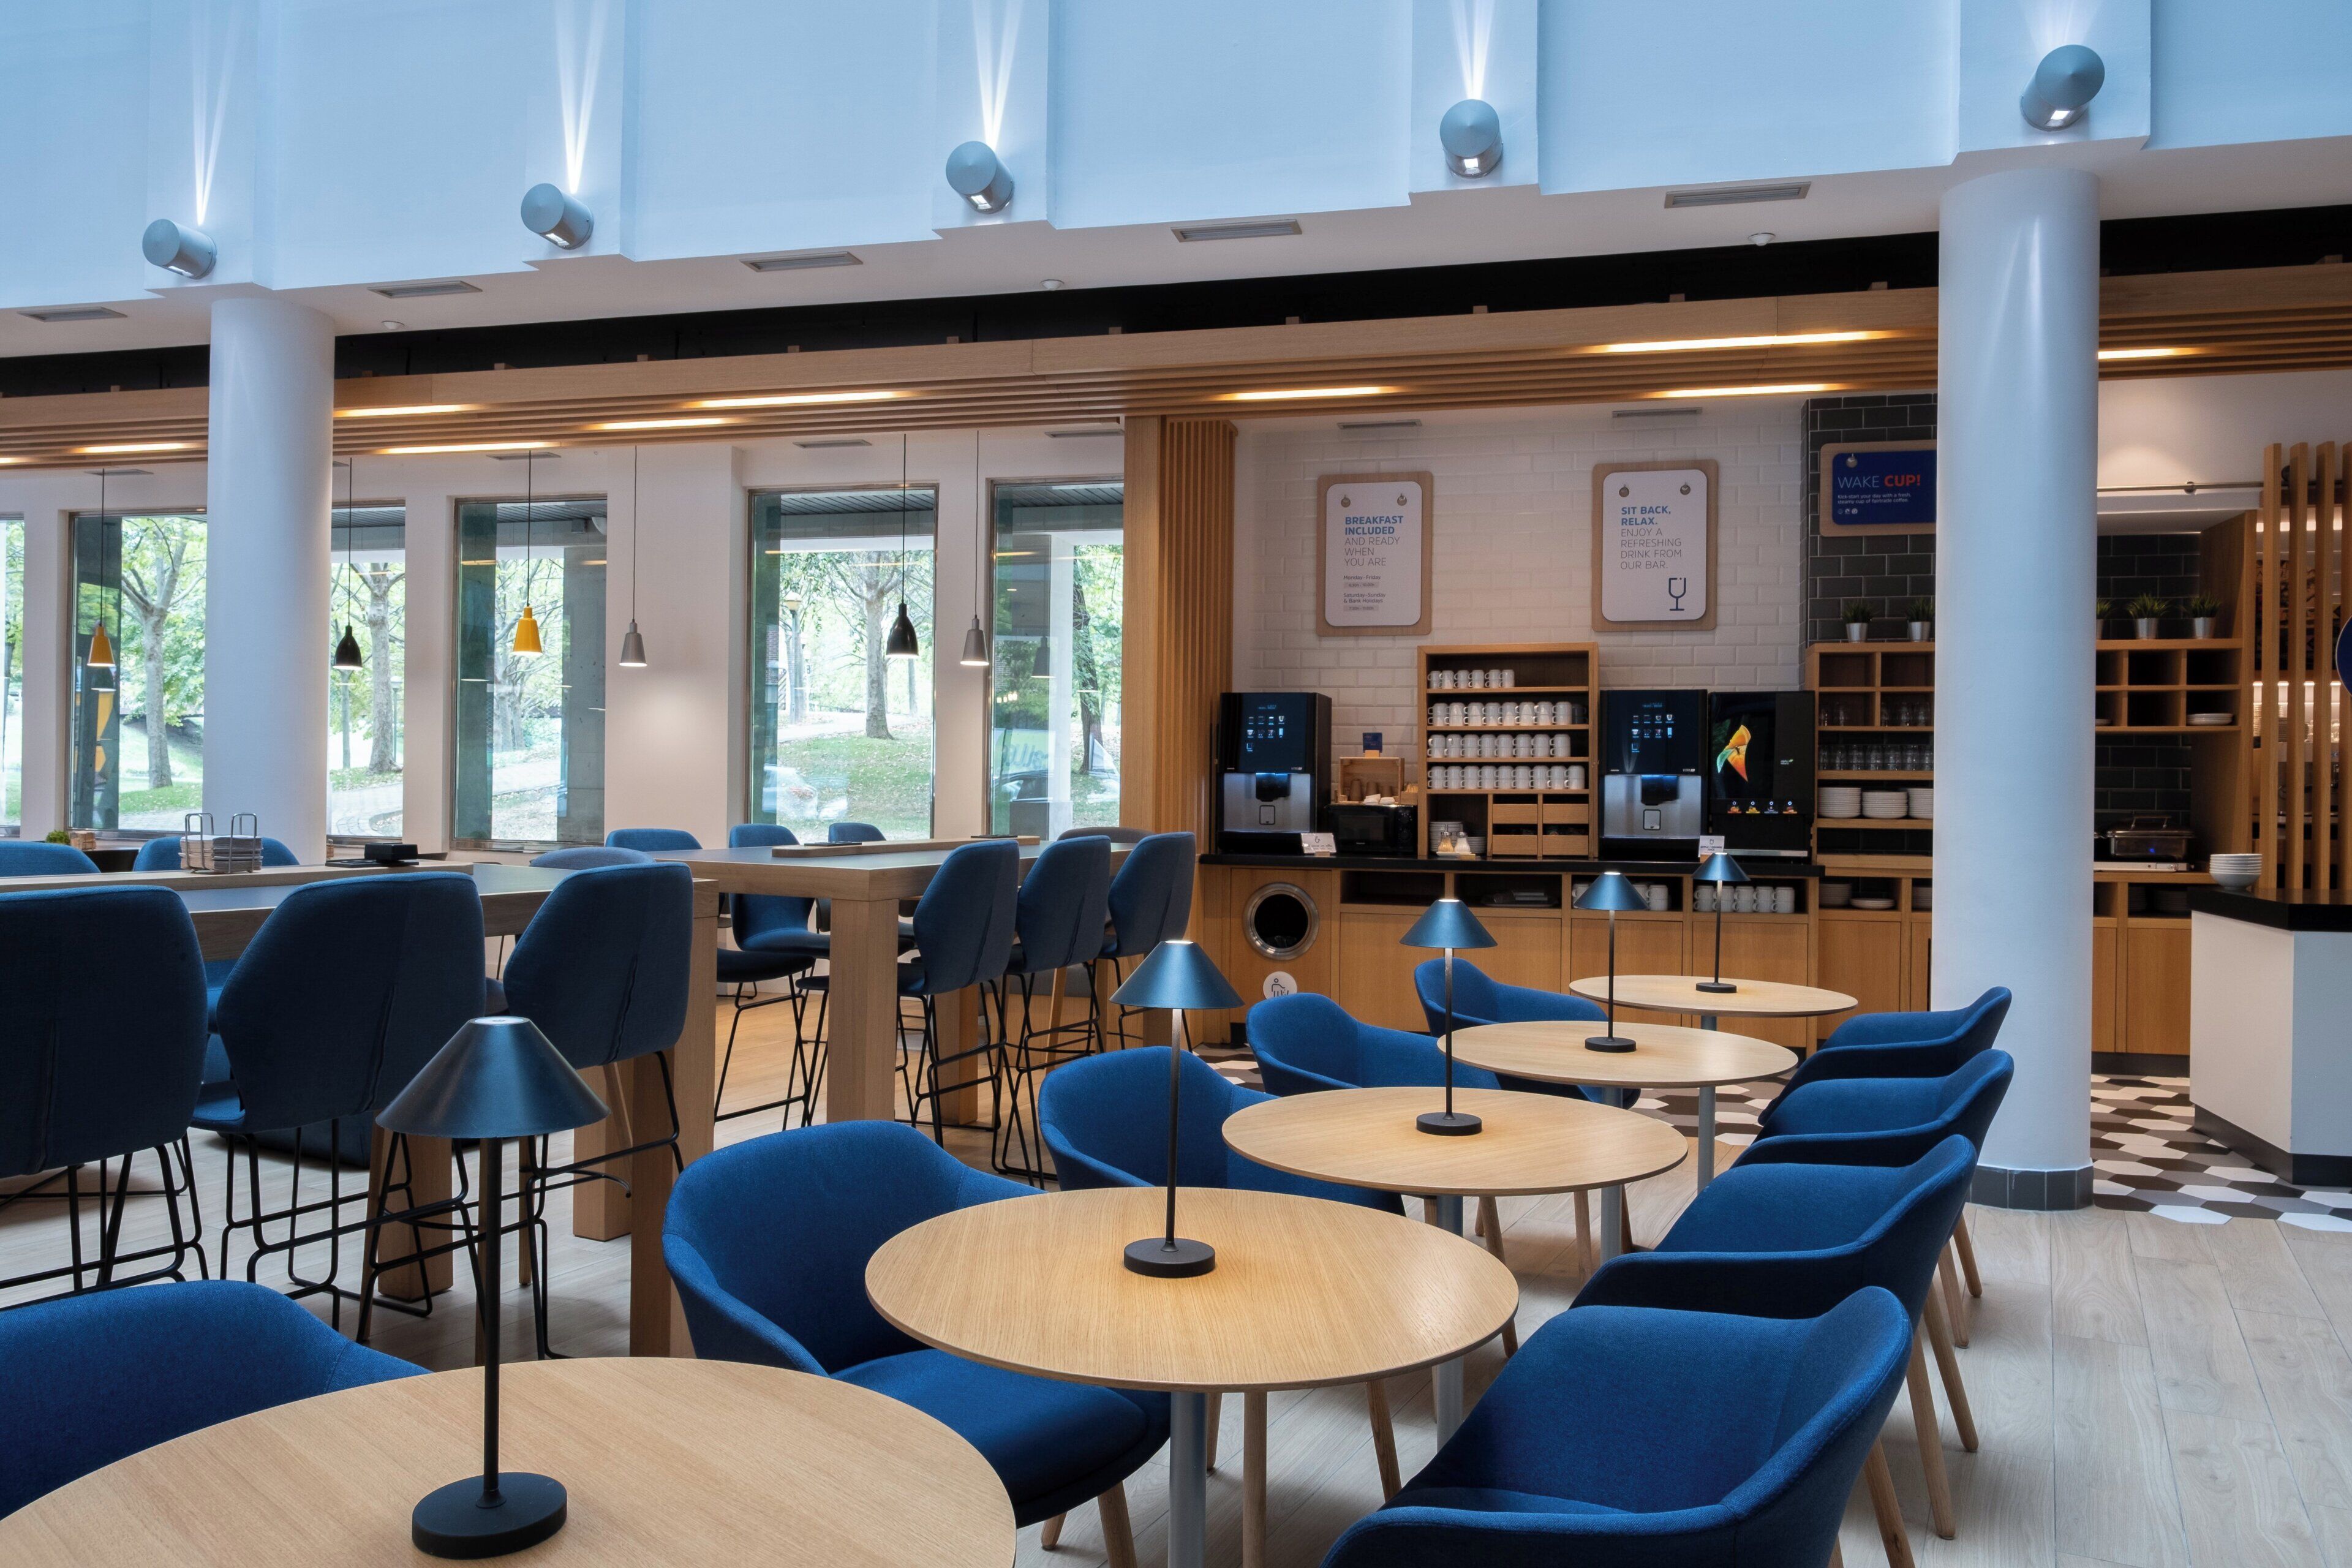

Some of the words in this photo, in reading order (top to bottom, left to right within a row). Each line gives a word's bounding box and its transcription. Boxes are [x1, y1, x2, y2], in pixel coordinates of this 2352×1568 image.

[1838, 476, 1880, 489] WAKE
[1883, 474, 1921, 488] CUP!
[1621, 507, 1637, 515] SIT
[1640, 505, 1671, 515] BACK,
[1345, 516, 1404, 525] BREAKFAST
[1621, 517, 1657, 526] RELAX.
[1345, 526, 1395, 535] INCLUDED
[1621, 527, 1653, 537] ENJOY
[1656, 527, 1663, 536] A
[1344, 537, 1365, 546] AND
[1368, 536, 1401, 546] READY
[1621, 538, 1681, 548] REFRESHING
[1344, 547, 1374, 556] WHEN
[1621, 549, 1651, 559] DRINK
[1654, 549, 1682, 558] FROM
[1344, 557, 1365, 567] YOU
[1367, 557, 1387, 567] ARE
[1620, 560, 1642, 570] OUR
[1645, 560, 1668, 570] BAR.
